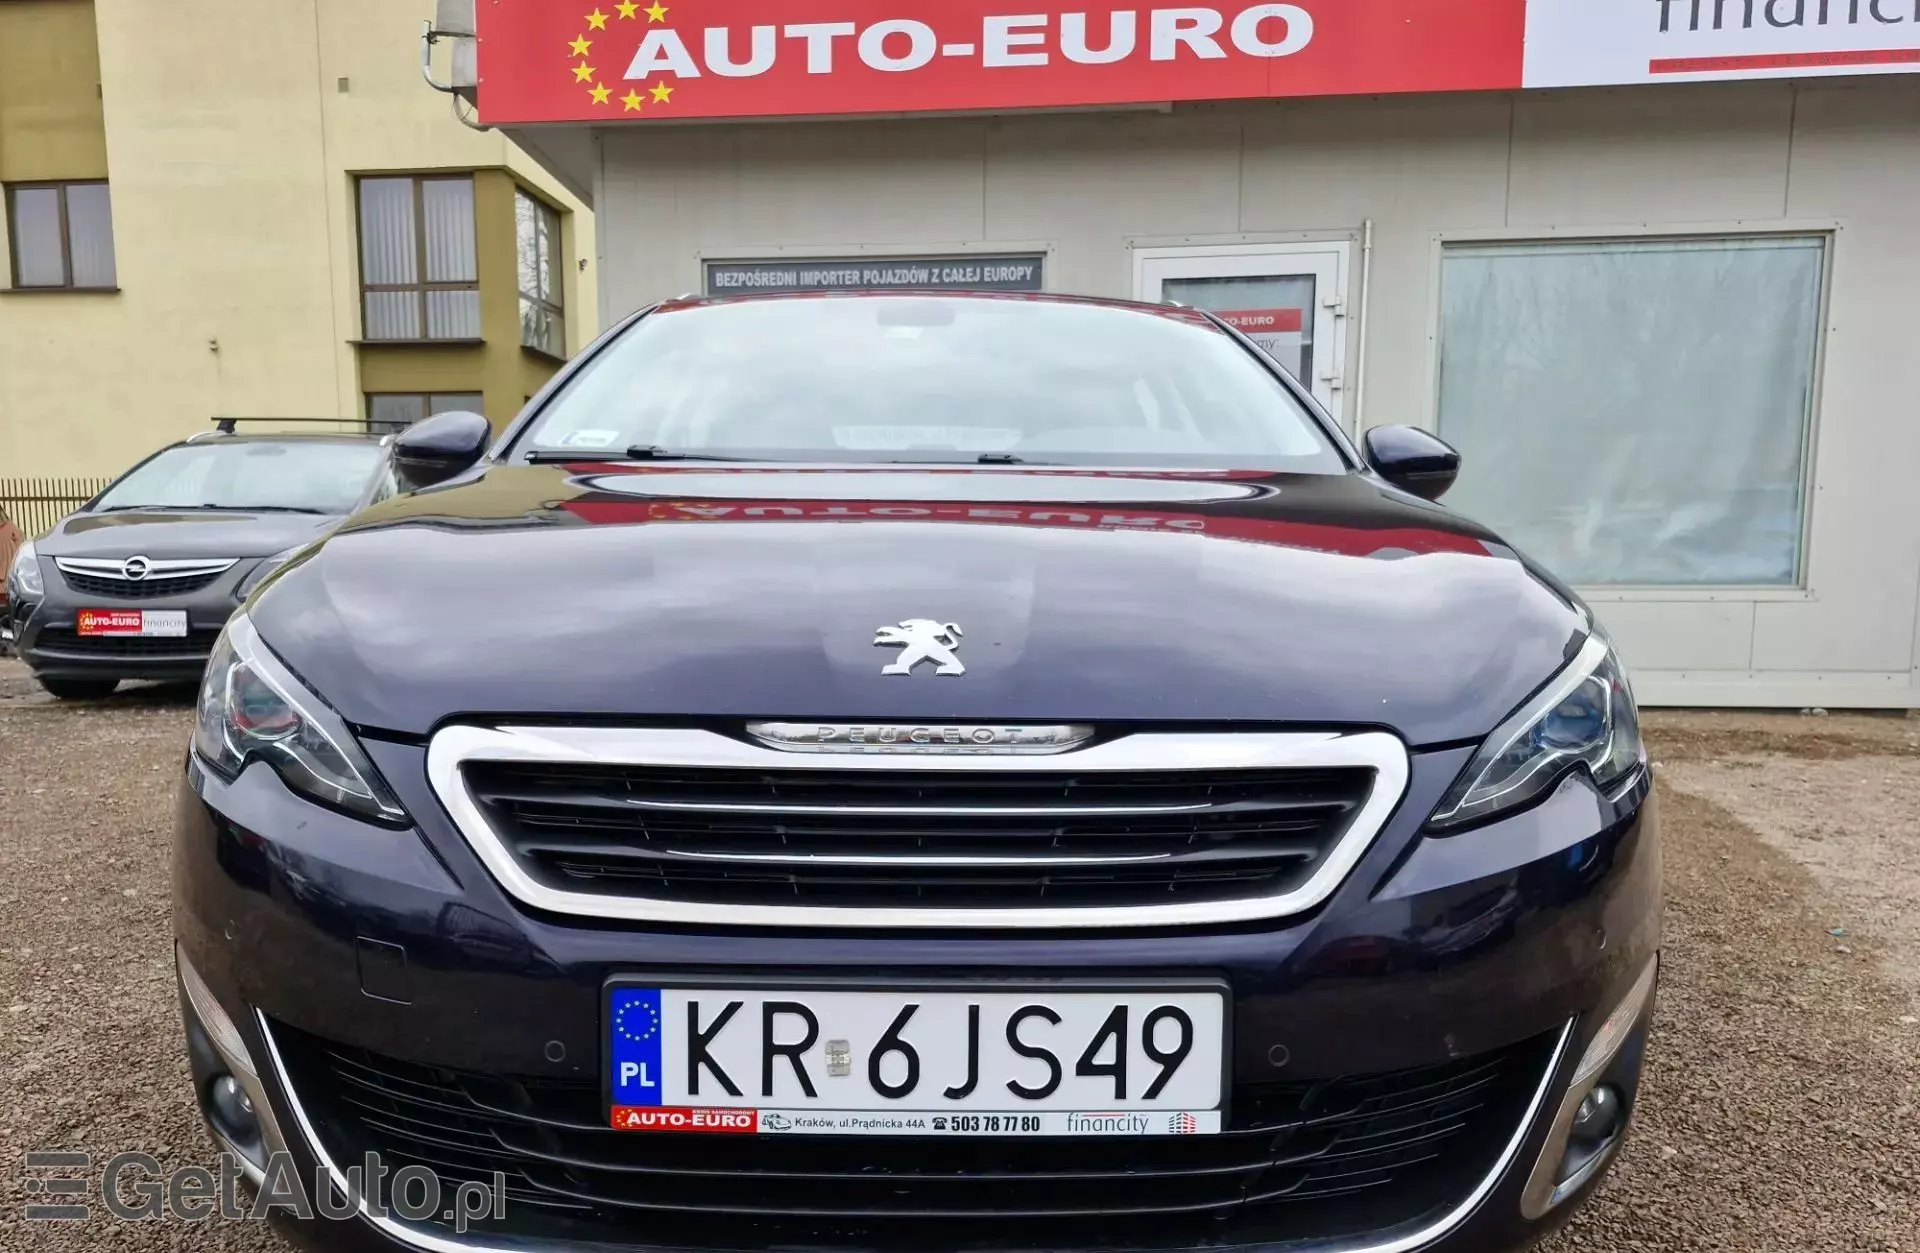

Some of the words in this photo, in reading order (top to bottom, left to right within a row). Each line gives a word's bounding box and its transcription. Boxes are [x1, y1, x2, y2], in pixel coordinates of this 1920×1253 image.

[622, 3, 1314, 80] AUTO-EURO
[715, 270, 797, 287] BEZPOŚREDNI
[800, 270, 861, 285] IMPORTER
[863, 267, 929, 284] POJAZDÓW
[931, 269, 940, 283] Z
[942, 267, 980, 282] CAŁEJ
[983, 266, 1033, 281] EUROPY
[83, 617, 140, 626] AUTO-EURO
[816, 727, 1023, 743] PEUGEOT
[687, 1001, 820, 1098] KR
[868, 1004, 1194, 1100] 6JS49
[620, 1062, 655, 1087] PL
[626, 1112, 752, 1127] AUTO-EURO
[795, 1117, 836, 1129] Kraków,
[905, 1119, 926, 1128] 44A
[951, 1116, 980, 1132] 503
[983, 1116, 1000, 1132] 78
[1003, 1116, 1019, 1132] 77
[1021, 1116, 1041, 1132] 80
[1067, 1112, 1150, 1134] financity
